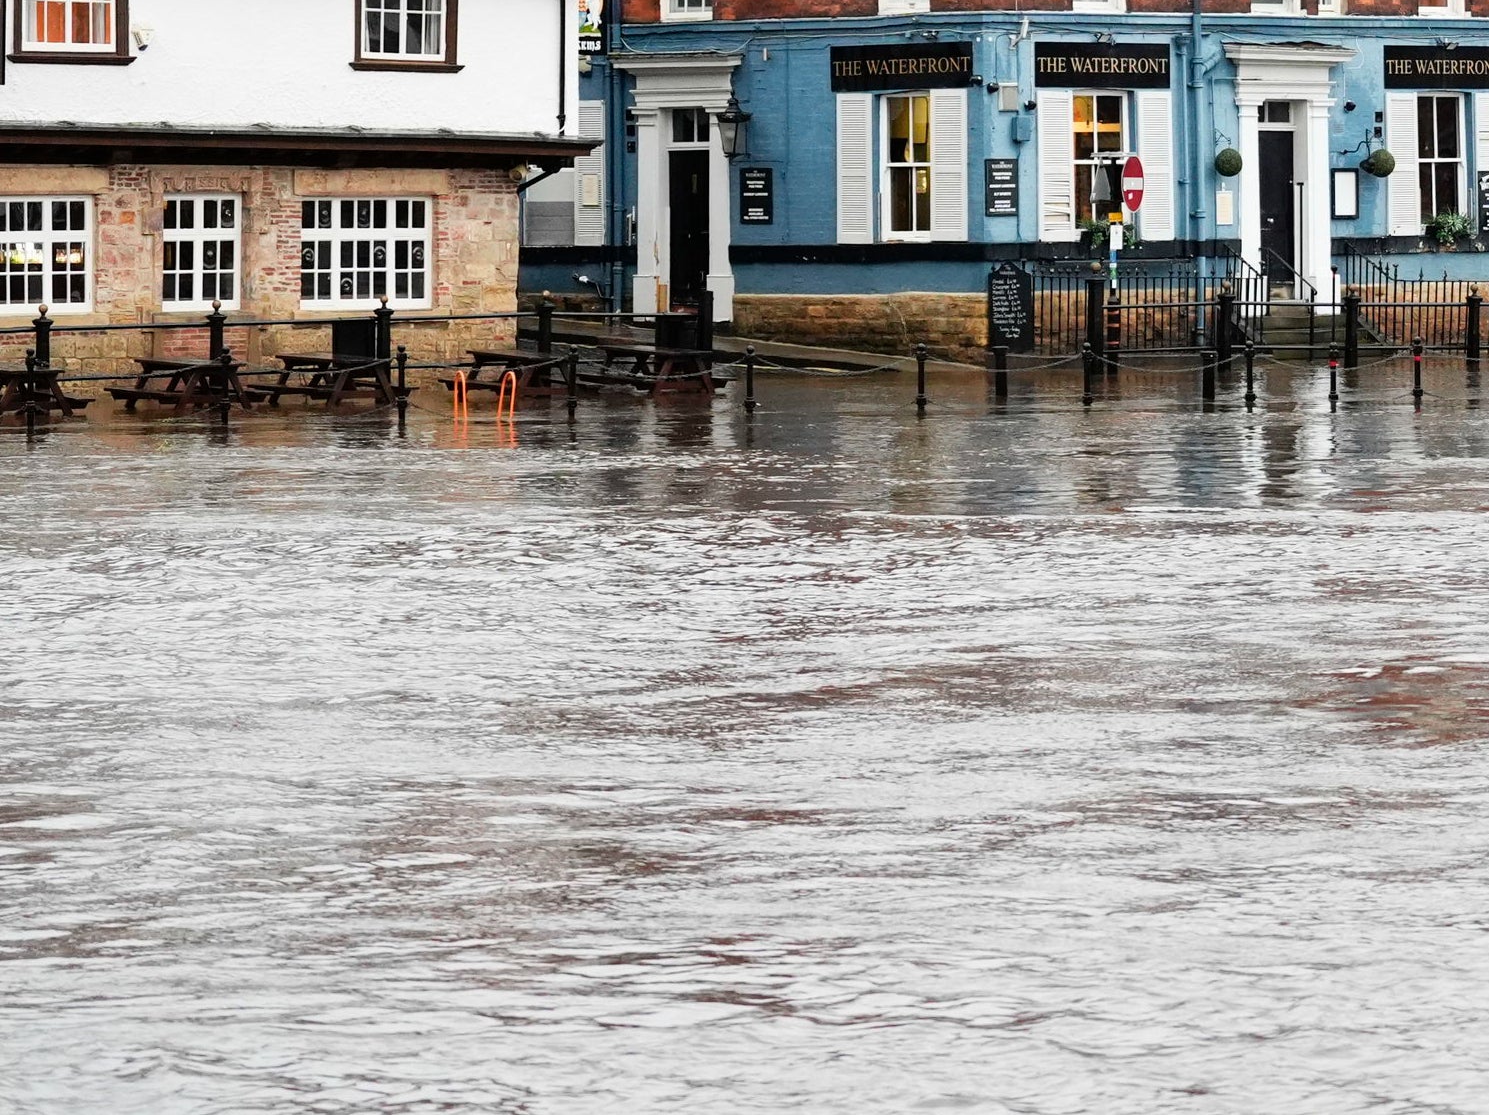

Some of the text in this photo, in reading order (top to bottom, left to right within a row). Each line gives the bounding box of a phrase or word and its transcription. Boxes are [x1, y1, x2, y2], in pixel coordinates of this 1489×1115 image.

[832, 56, 970, 76] THE WATERFRONT
[1038, 57, 1168, 74] THE WATERFRONT
[1386, 60, 1413, 74] THE
